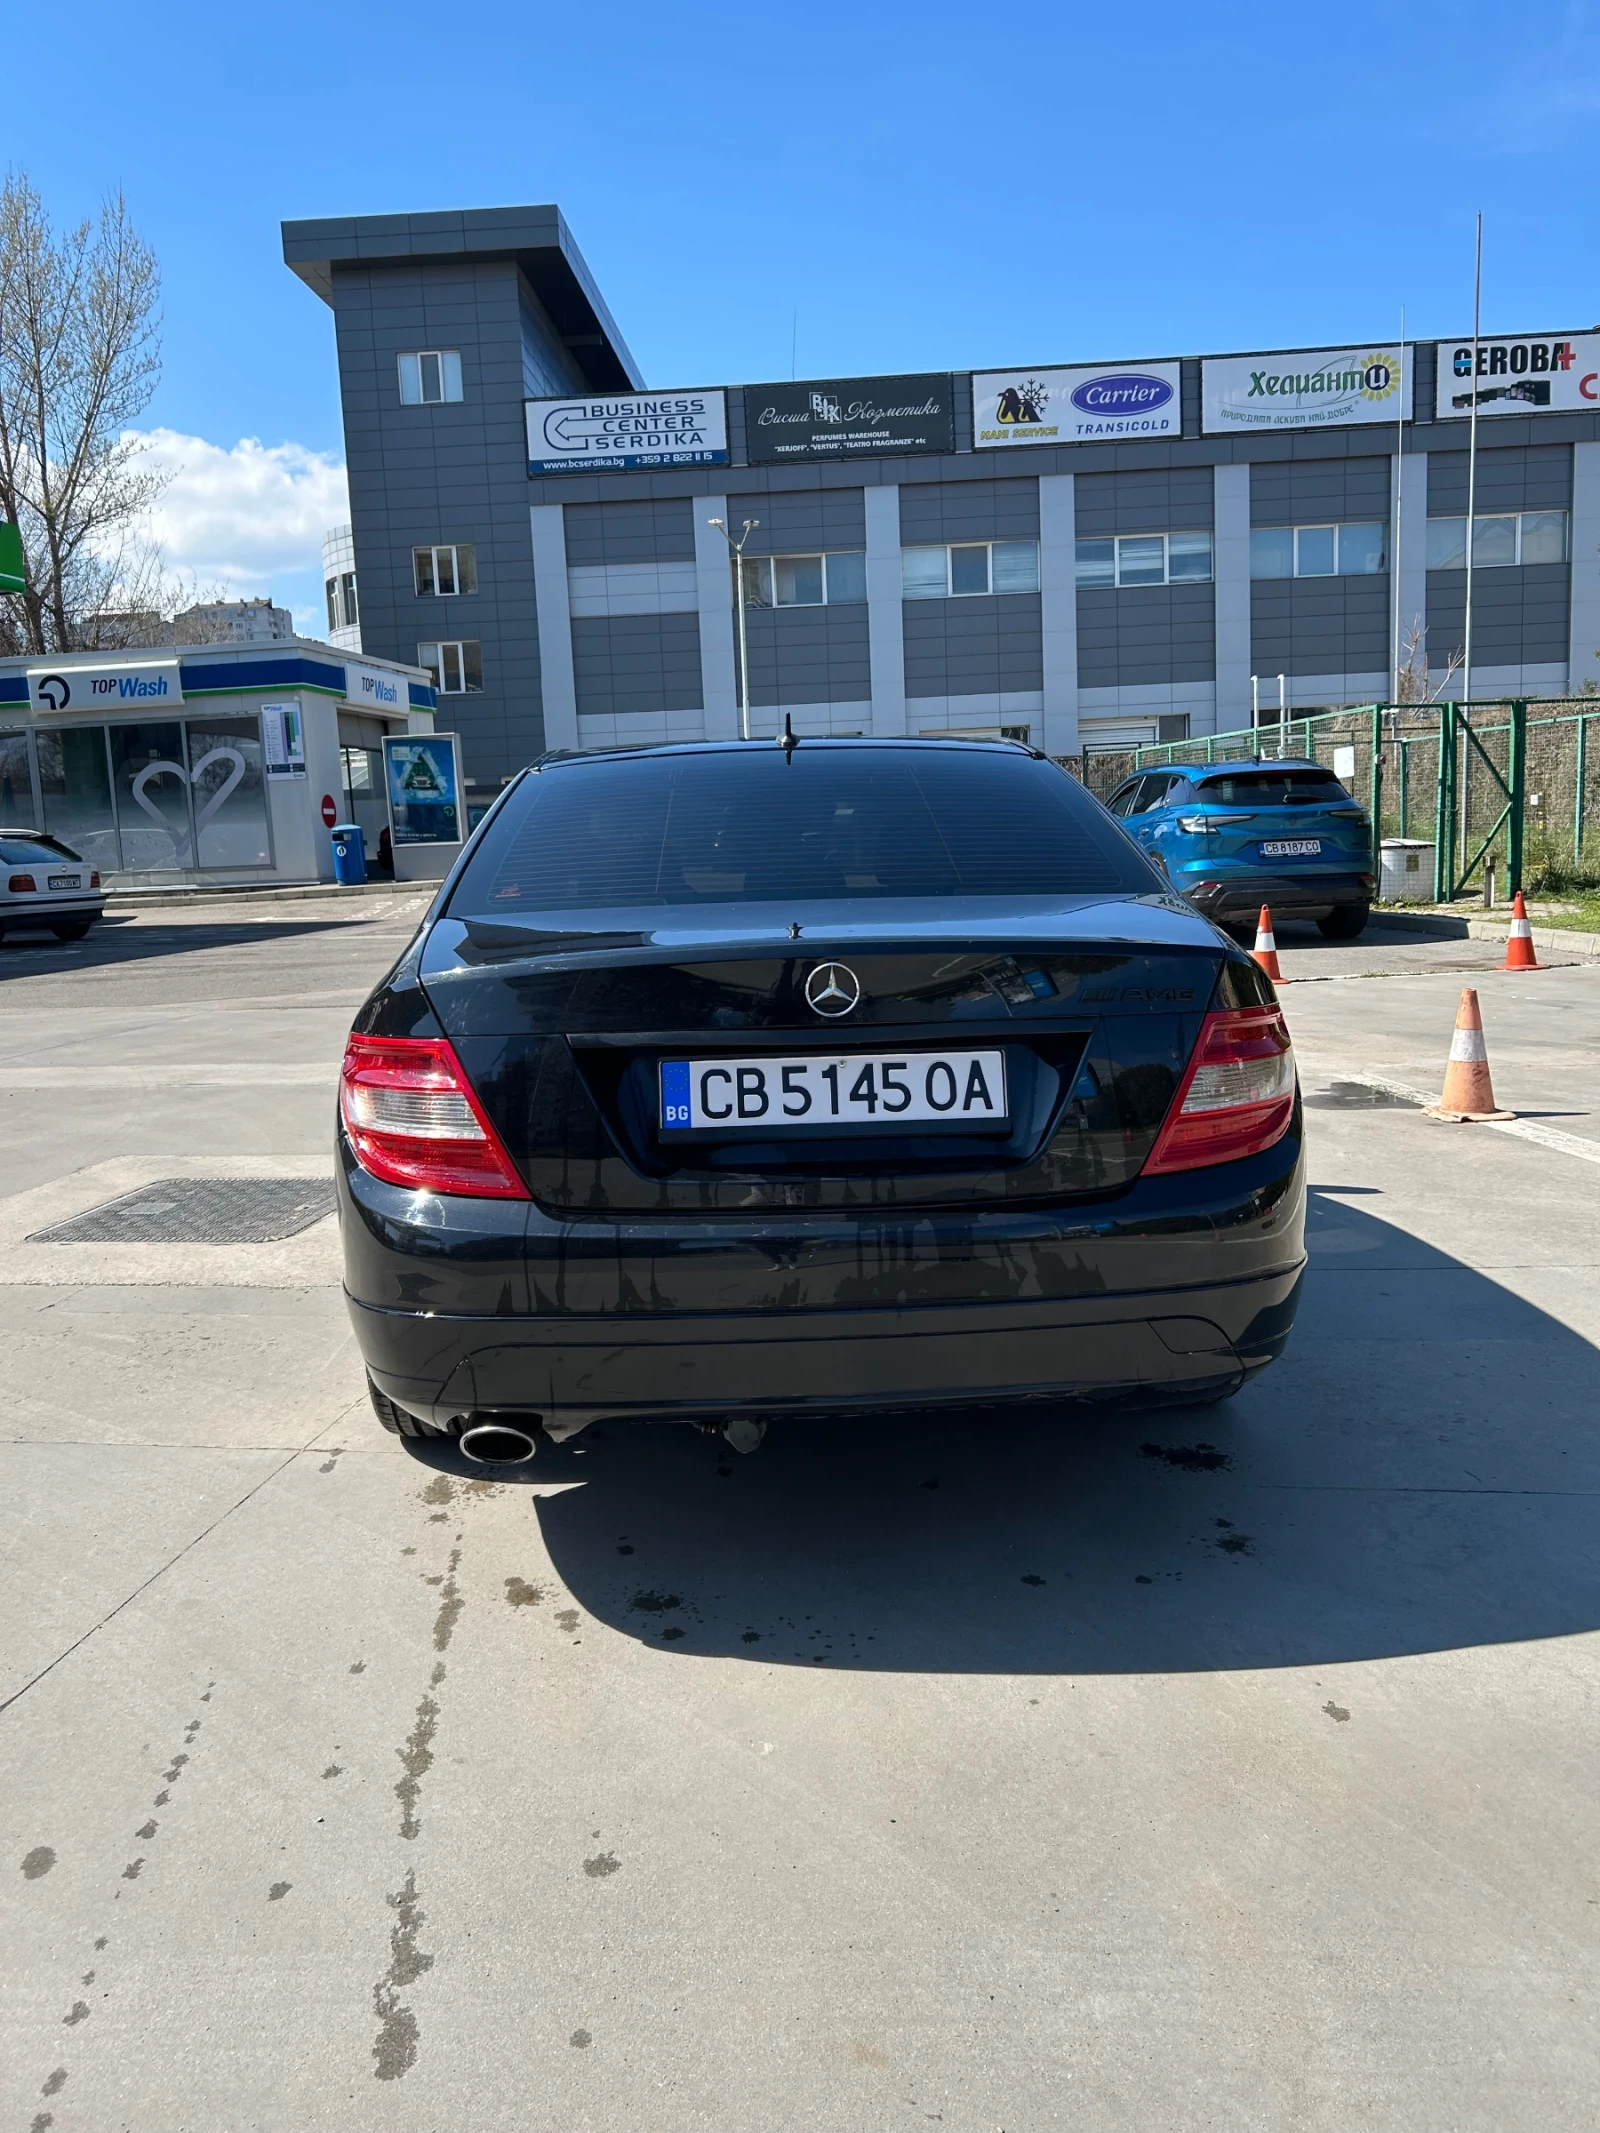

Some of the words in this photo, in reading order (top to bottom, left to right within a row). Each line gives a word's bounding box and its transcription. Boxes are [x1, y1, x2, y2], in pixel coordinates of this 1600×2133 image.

[1086, 384, 1160, 405] Carrier
[591, 399, 704, 418] BUSINESS
[758, 408, 810, 425] Висша
[844, 397, 941, 424] Козметика
[602, 416, 694, 432] CENTER
[1076, 419, 1169, 434] TRANSICOLD
[595, 432, 704, 449] SERDIKA
[811, 433, 847, 442] PERFUMES
[848, 431, 890, 440] WAREHOUSE
[980, 429, 1009, 440] MANI
[1012, 426, 1059, 439] SERVICE
[543, 457, 625, 470] www.bcserdika.bg
[635, 455, 661, 464] +359
[663, 454, 670, 463] 2
[673, 453, 692, 462] 822
[1265, 843, 1279, 853] CB
[1280, 842, 1304, 853] 8187
[666, 1105, 689, 1122] BG
